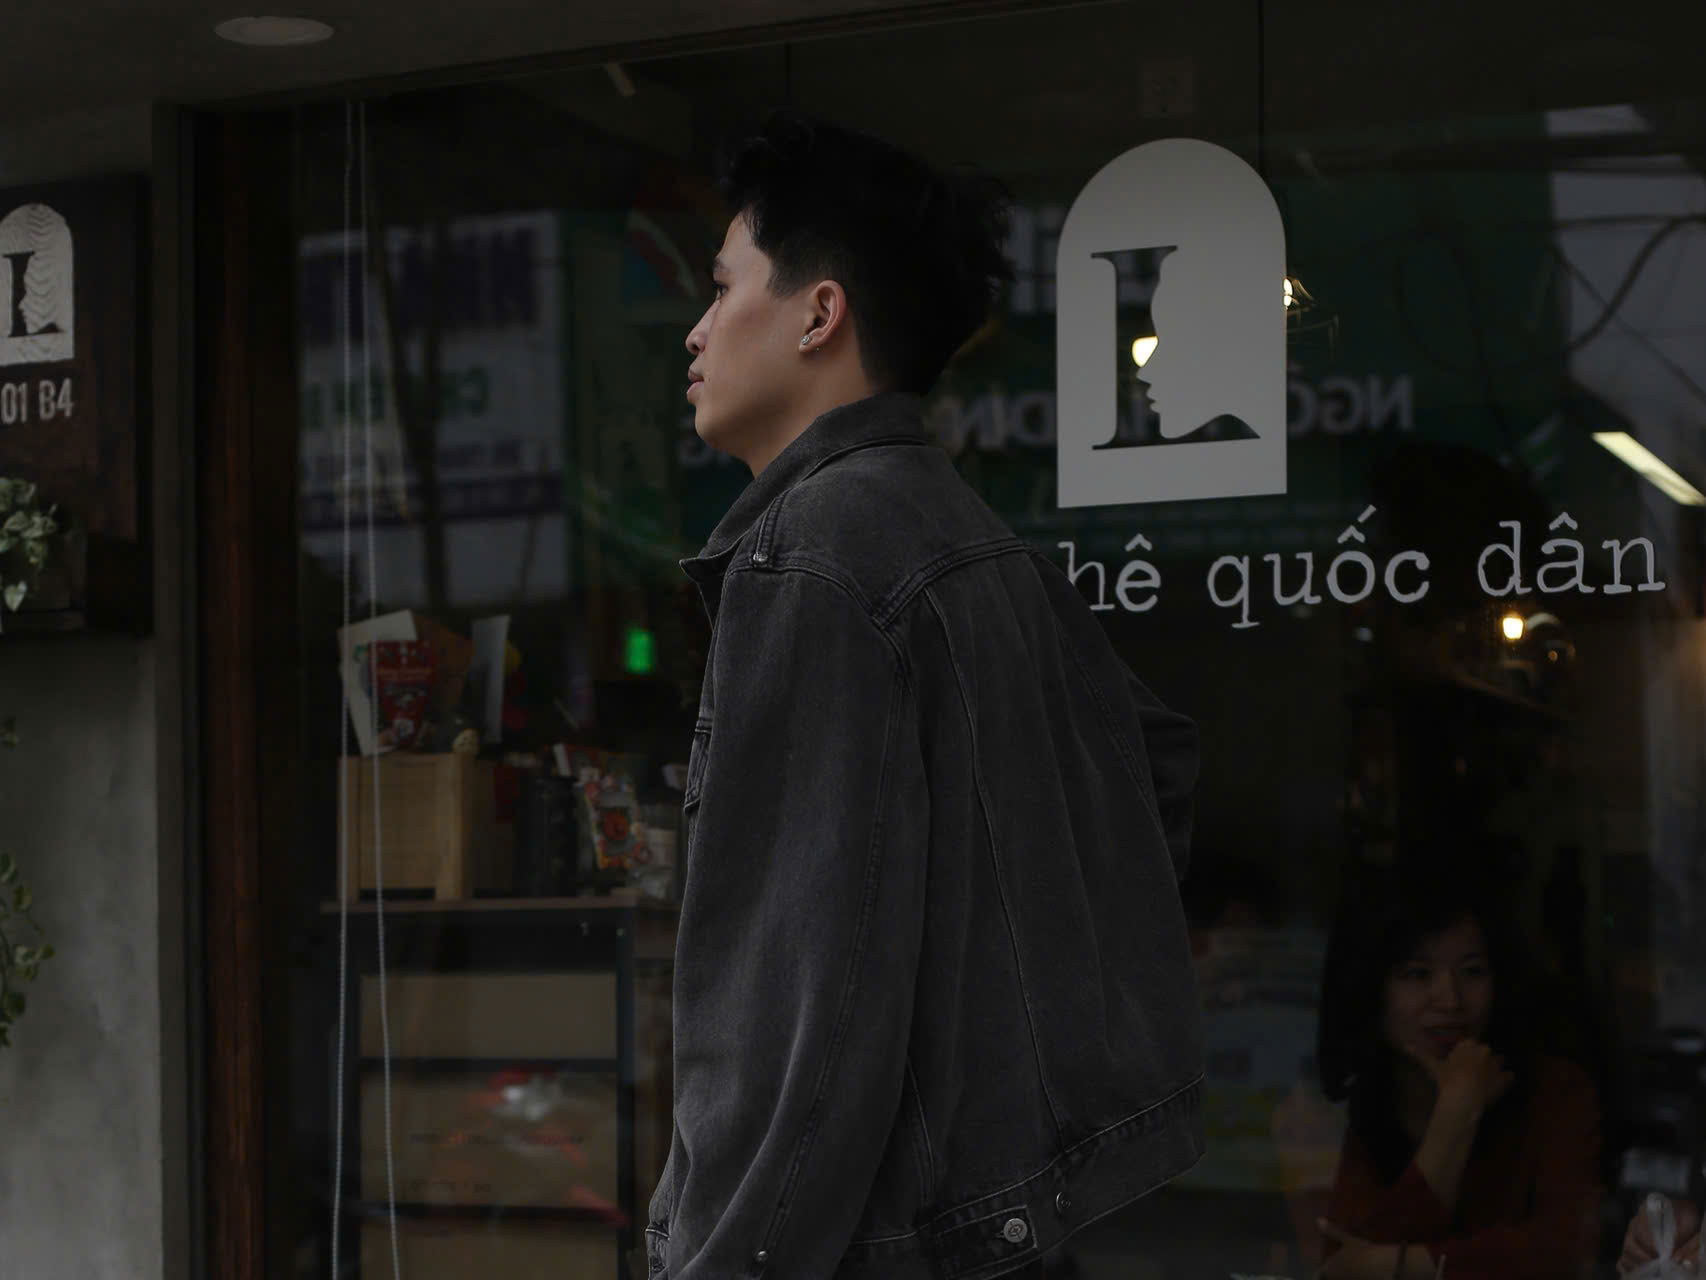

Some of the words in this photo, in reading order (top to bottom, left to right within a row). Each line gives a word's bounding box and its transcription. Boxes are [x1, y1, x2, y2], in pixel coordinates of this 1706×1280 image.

[1, 381, 28, 425] 01
[39, 376, 75, 421] B4
[1207, 504, 1430, 629] quốc
[1477, 512, 1666, 597] dân
